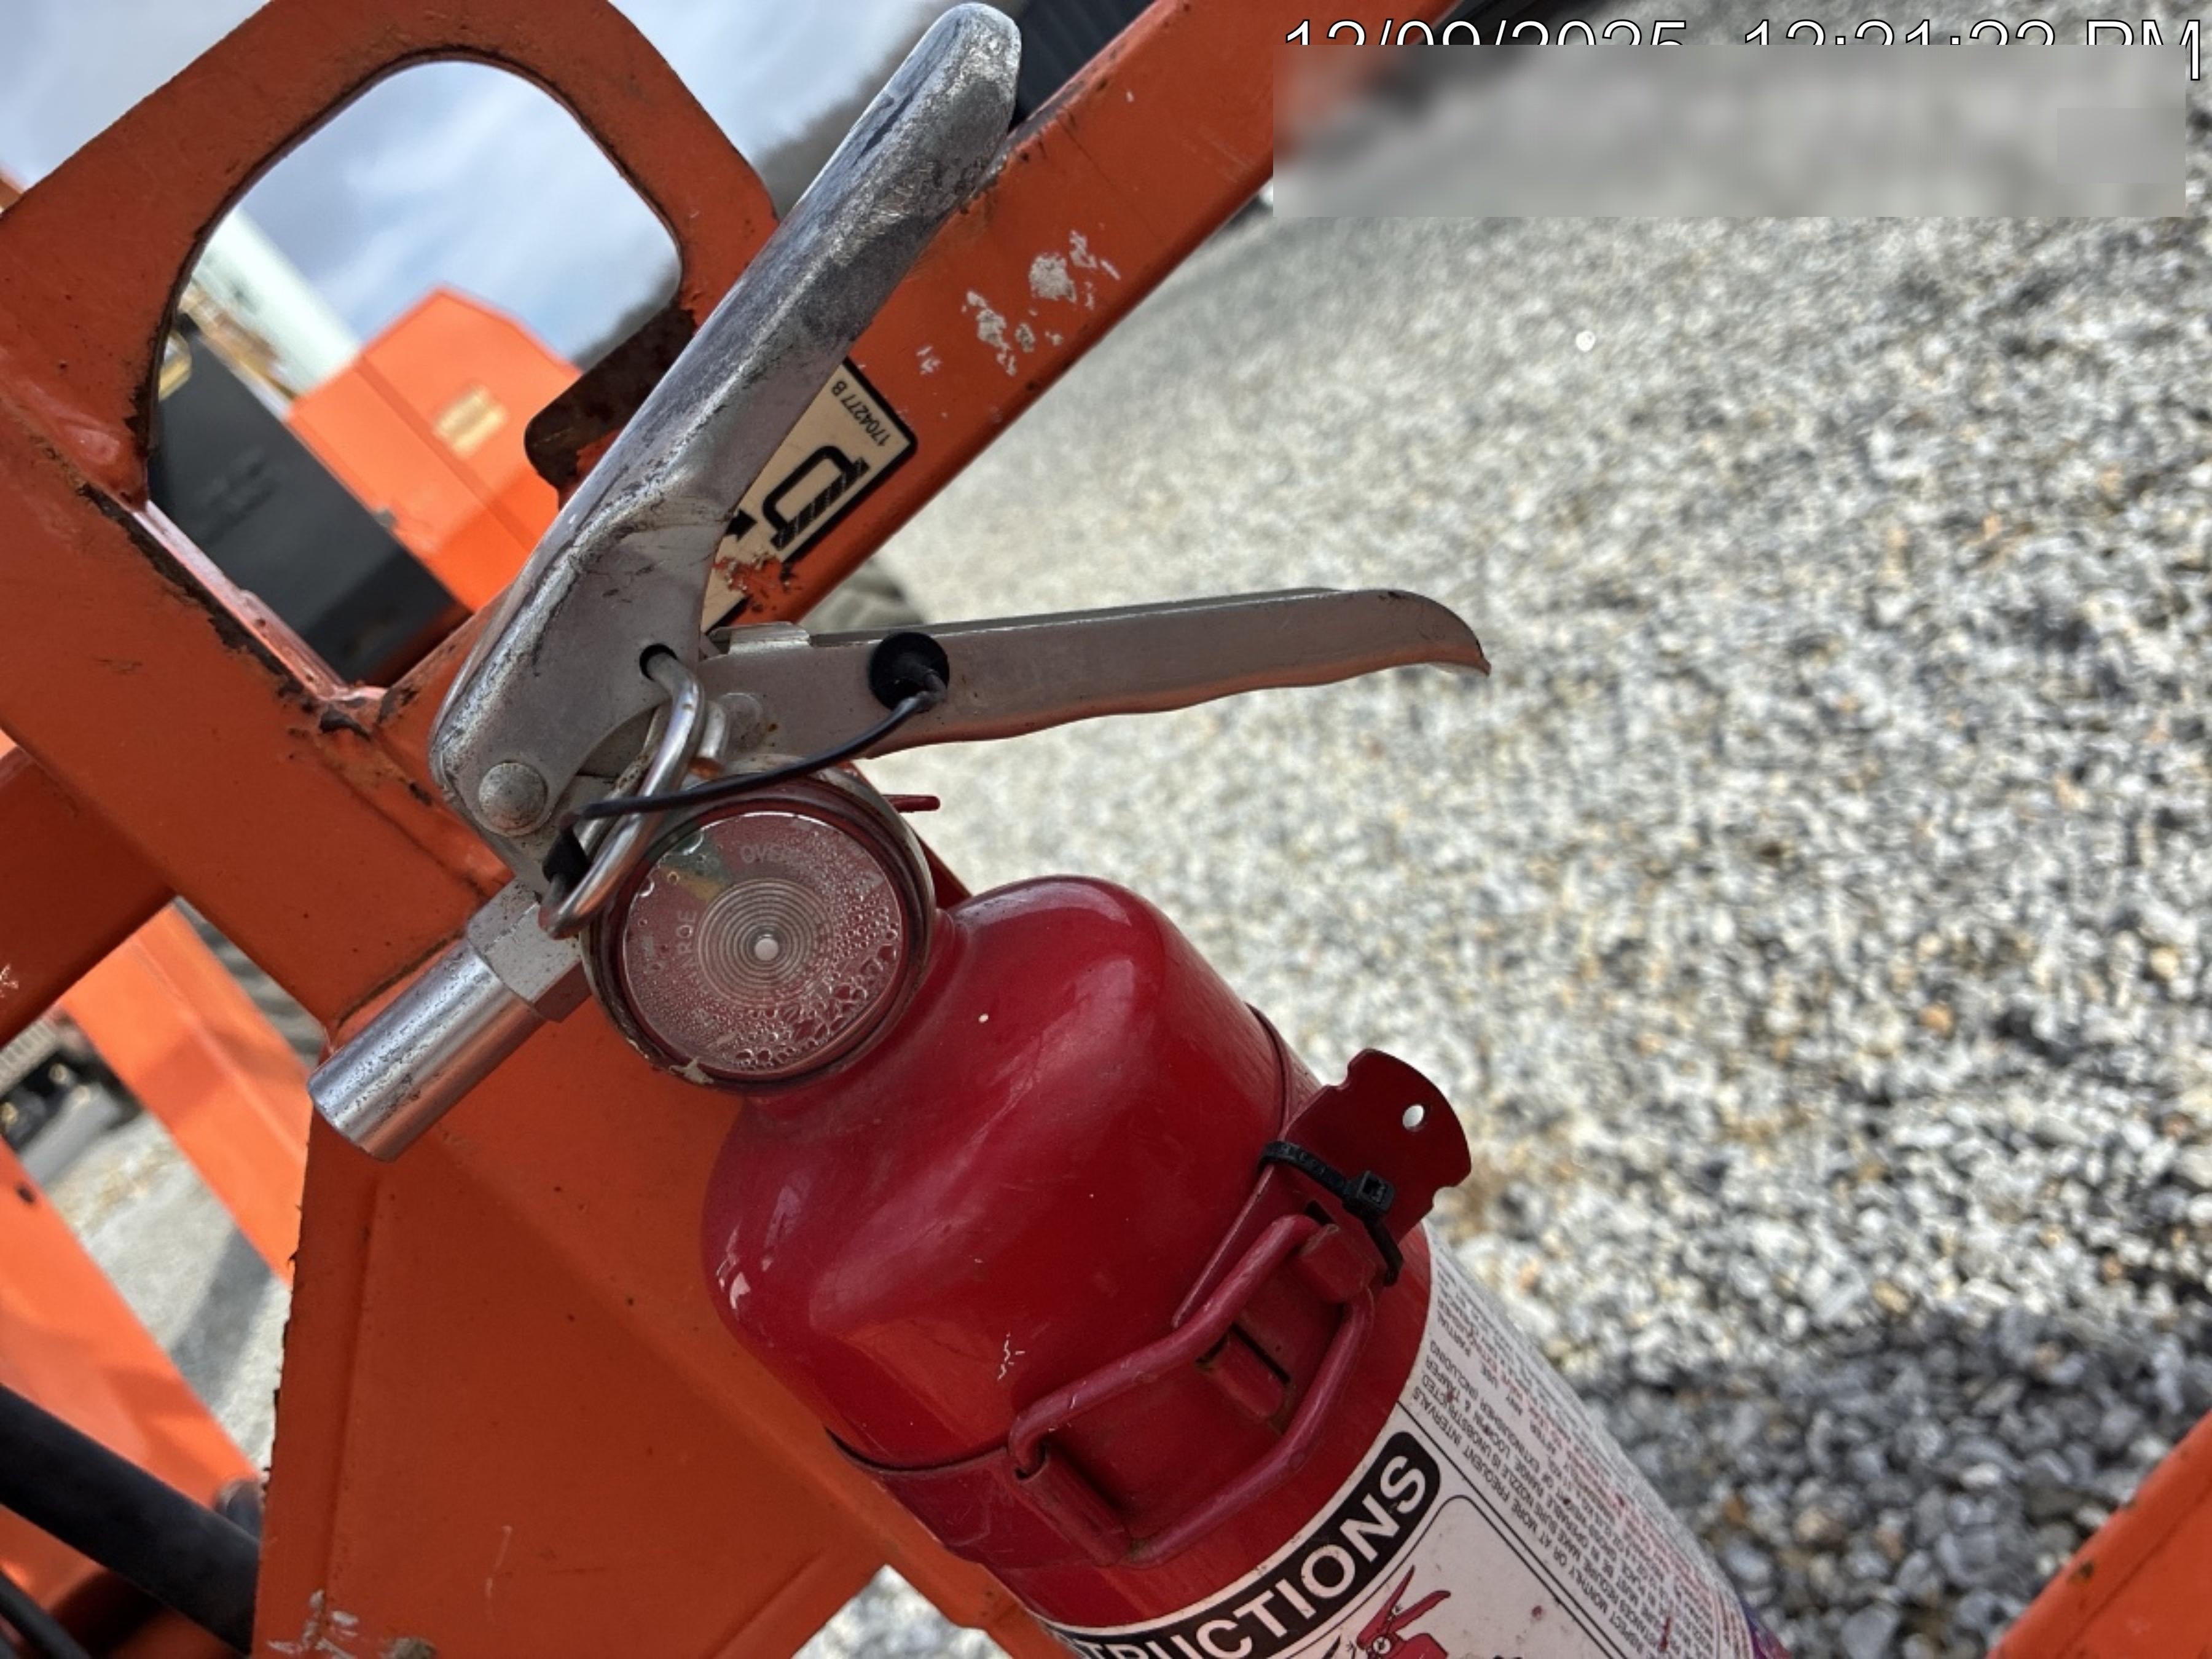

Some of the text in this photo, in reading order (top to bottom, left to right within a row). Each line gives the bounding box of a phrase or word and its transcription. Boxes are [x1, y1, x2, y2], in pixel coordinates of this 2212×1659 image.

[831, 380, 892, 447] 1704277 B
[1424, 1352, 1461, 1403] TAMPER
[1478, 1396, 1540, 1475] EXTINGUISHER
[1491, 1450, 1501, 1472] IS
[1500, 1462, 1534, 1510] NOZZLE
[1555, 1484, 1588, 1531] WEIGT
[1412, 1382, 1644, 1657] INSPECT MONTHLY OR AT MORE FREQUENT INTERVALS
[1533, 1499, 1558, 1537] SURE
[1545, 1493, 1589, 1552] OPERABLE
[1556, 1526, 1582, 1565] MAKE
[1601, 1557, 1614, 1580] BE
